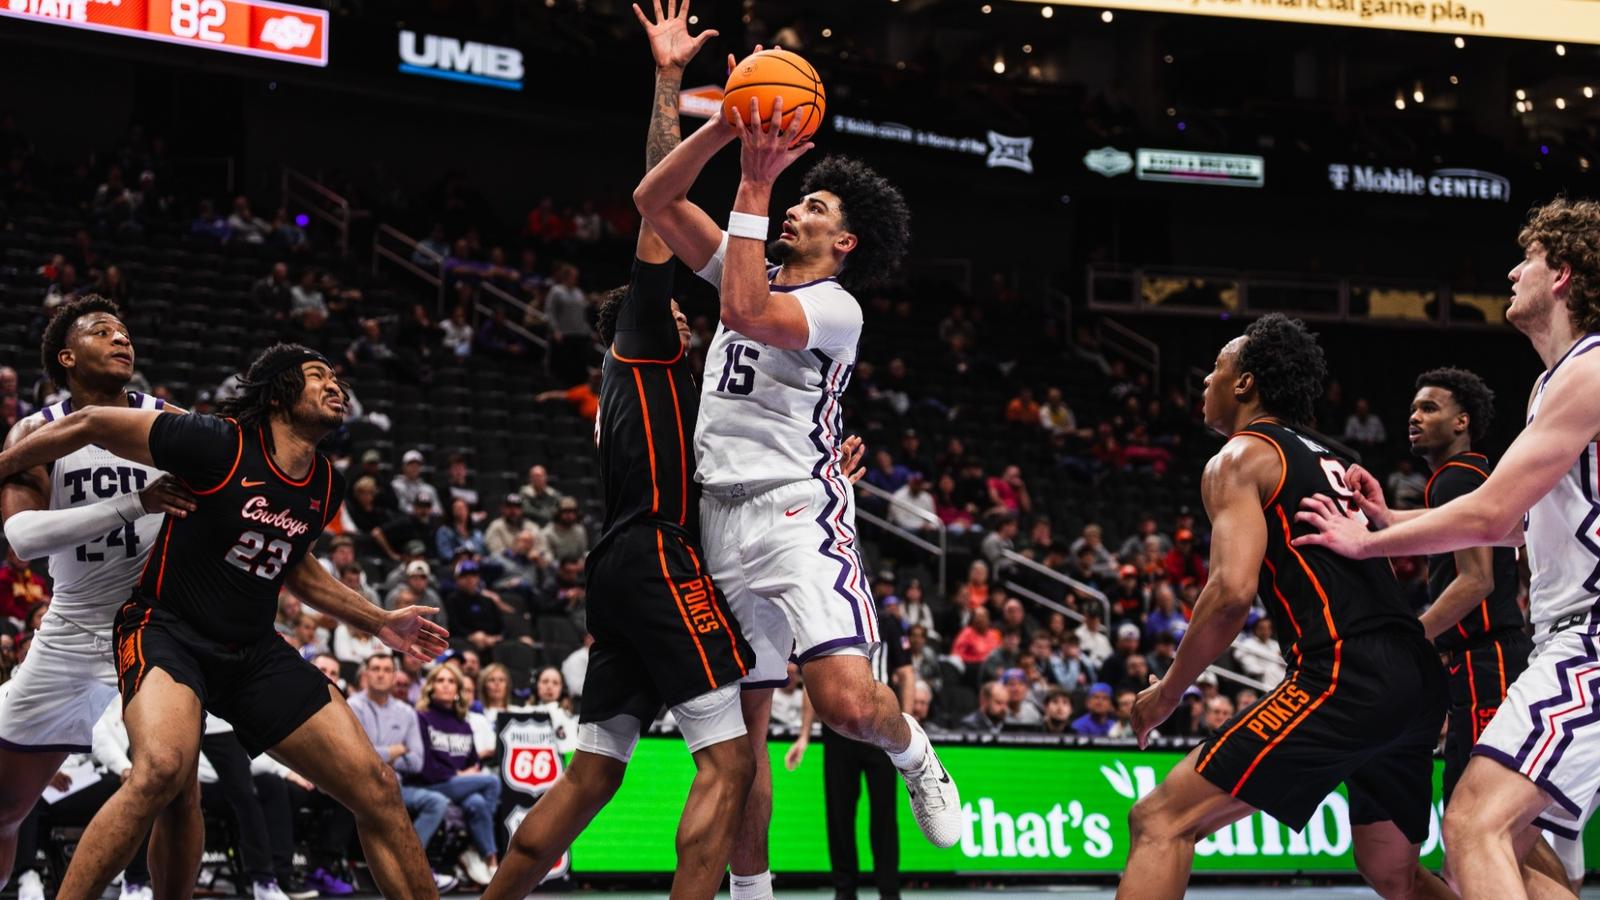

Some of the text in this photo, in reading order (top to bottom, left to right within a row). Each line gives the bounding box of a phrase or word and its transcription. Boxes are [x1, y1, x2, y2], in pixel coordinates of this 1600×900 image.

[170, 0, 227, 43] 82
[1360, 1, 1427, 18] game
[1431, 2, 1485, 27] plan
[398, 29, 524, 80] UMB
[1353, 164, 1425, 195] Mobile
[1428, 175, 1503, 200] CENTER
[716, 343, 761, 396] 15
[63, 466, 148, 505] TCU
[241, 495, 309, 538] Cowboys
[224, 530, 293, 581] 23
[679, 578, 720, 634] POKES
[1246, 683, 1311, 741] POKES
[513, 750, 553, 780] 66
[960, 797, 1114, 859] that's
